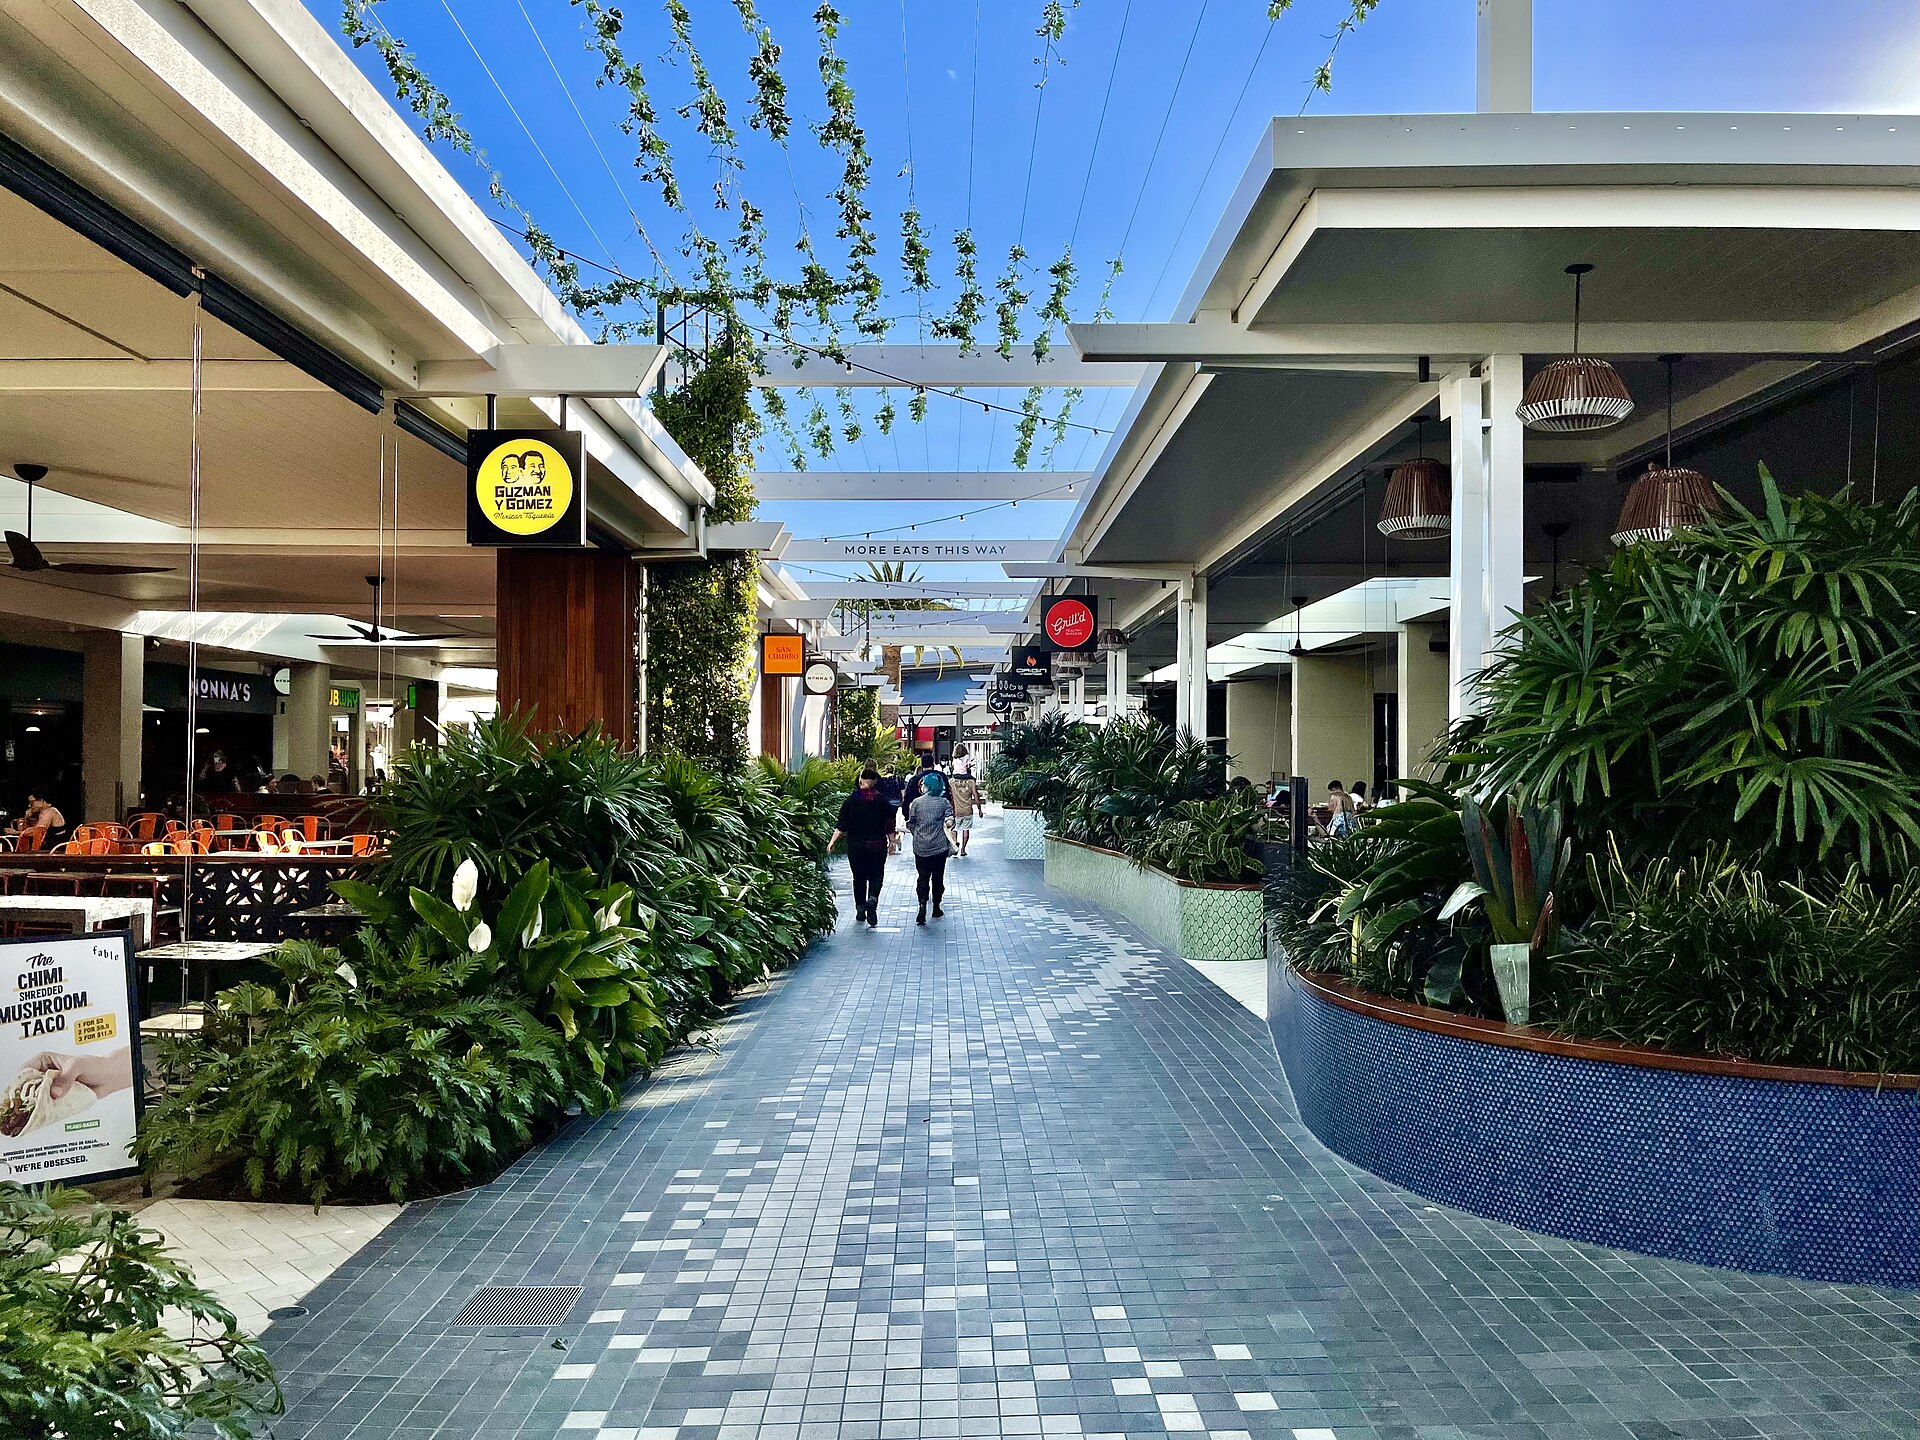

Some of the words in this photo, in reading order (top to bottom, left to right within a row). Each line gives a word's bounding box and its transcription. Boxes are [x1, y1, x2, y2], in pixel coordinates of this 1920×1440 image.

[495, 486, 551, 497] GUZMAN
[494, 499, 504, 511] Y
[506, 498, 553, 510] GOMEZ
[845, 545, 887, 555] MORE
[893, 545, 930, 555] EATS
[935, 545, 970, 555] THIS
[975, 545, 1007, 555] WAY
[1051, 610, 1086, 636] Grill'd
[26, 953, 54, 969] The
[93, 945, 119, 961] fable
[18, 967, 63, 989] CHIMI
[20, 985, 63, 1001] SHREDDED
[0, 991, 88, 1023] MUSHROOM
[21, 1014, 66, 1038] TACO
[83, 1019, 95, 1027] FOR
[84, 1033, 96, 1041] FOR
[14, 1161, 42, 1173] WE'RE
[43, 1155, 88, 1168] OBSESSED.
